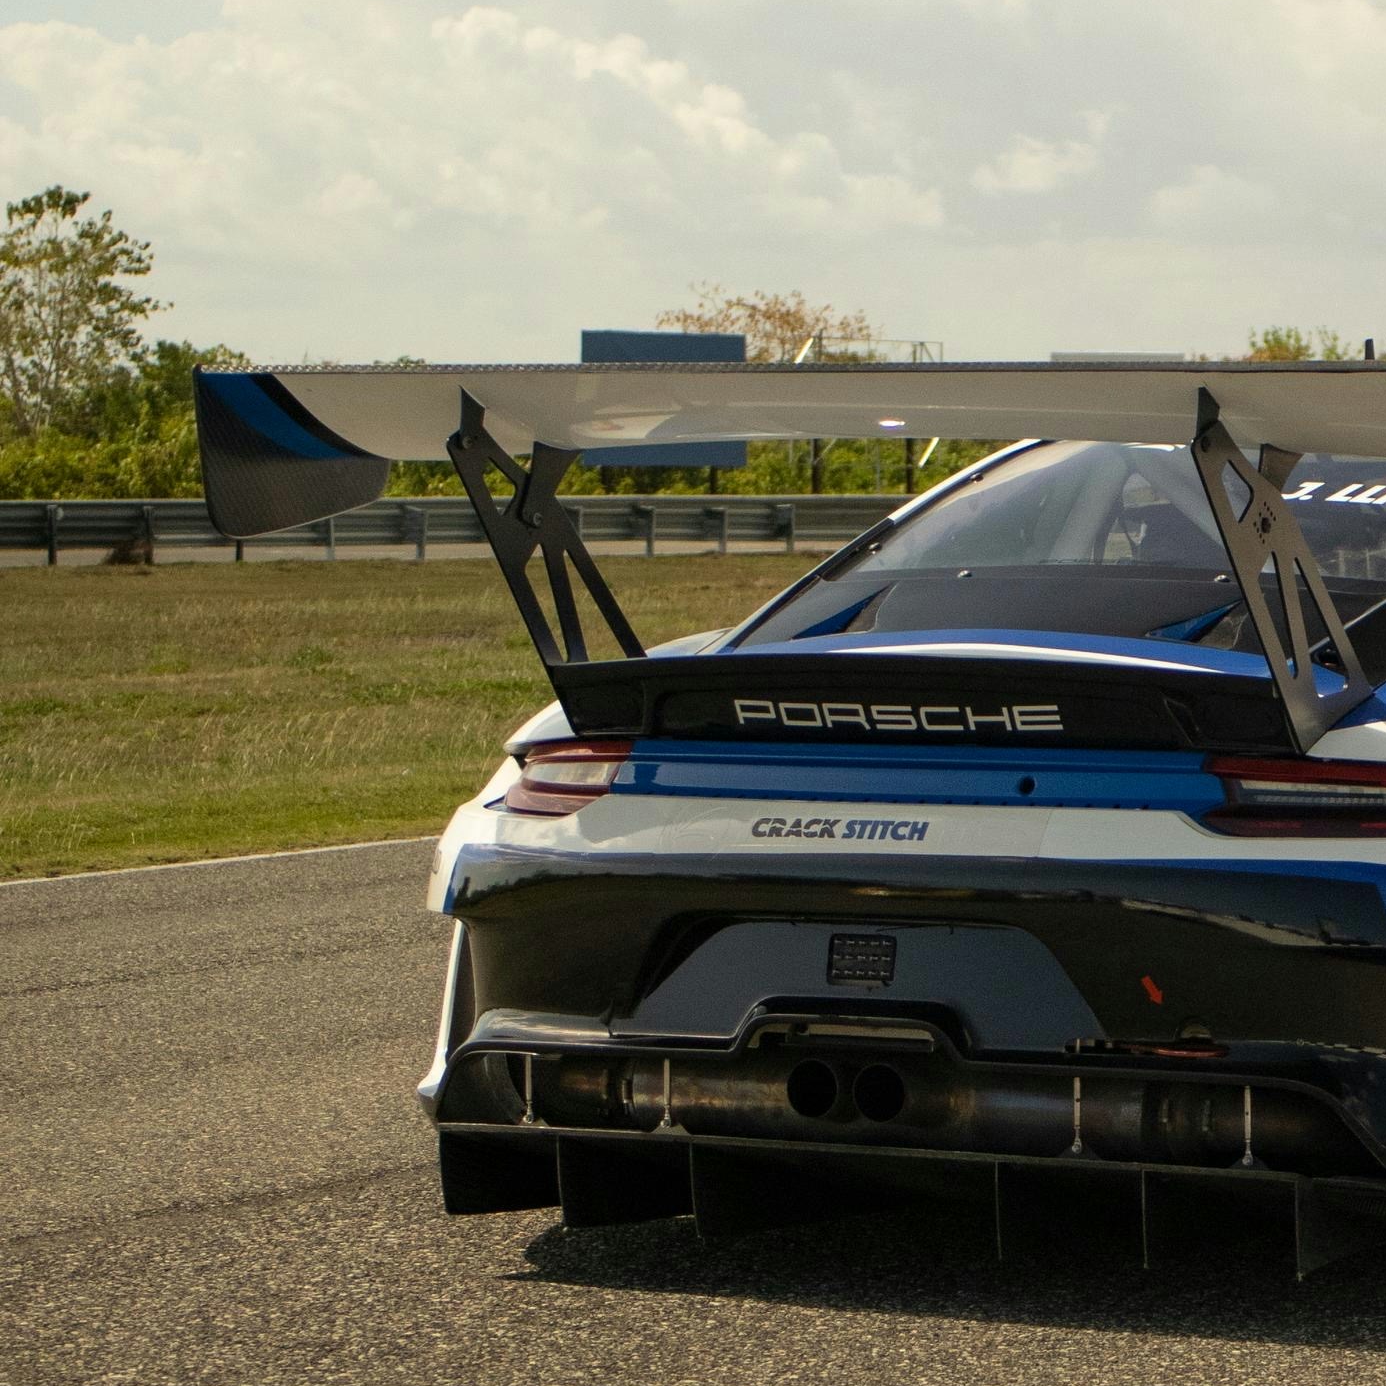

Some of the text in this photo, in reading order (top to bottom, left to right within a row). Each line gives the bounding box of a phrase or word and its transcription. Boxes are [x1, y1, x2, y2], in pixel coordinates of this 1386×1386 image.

[1281, 481, 1325, 501] J.
[733, 699, 1064, 731] PORSCHE
[751, 817, 930, 842] CRACK STITCH
